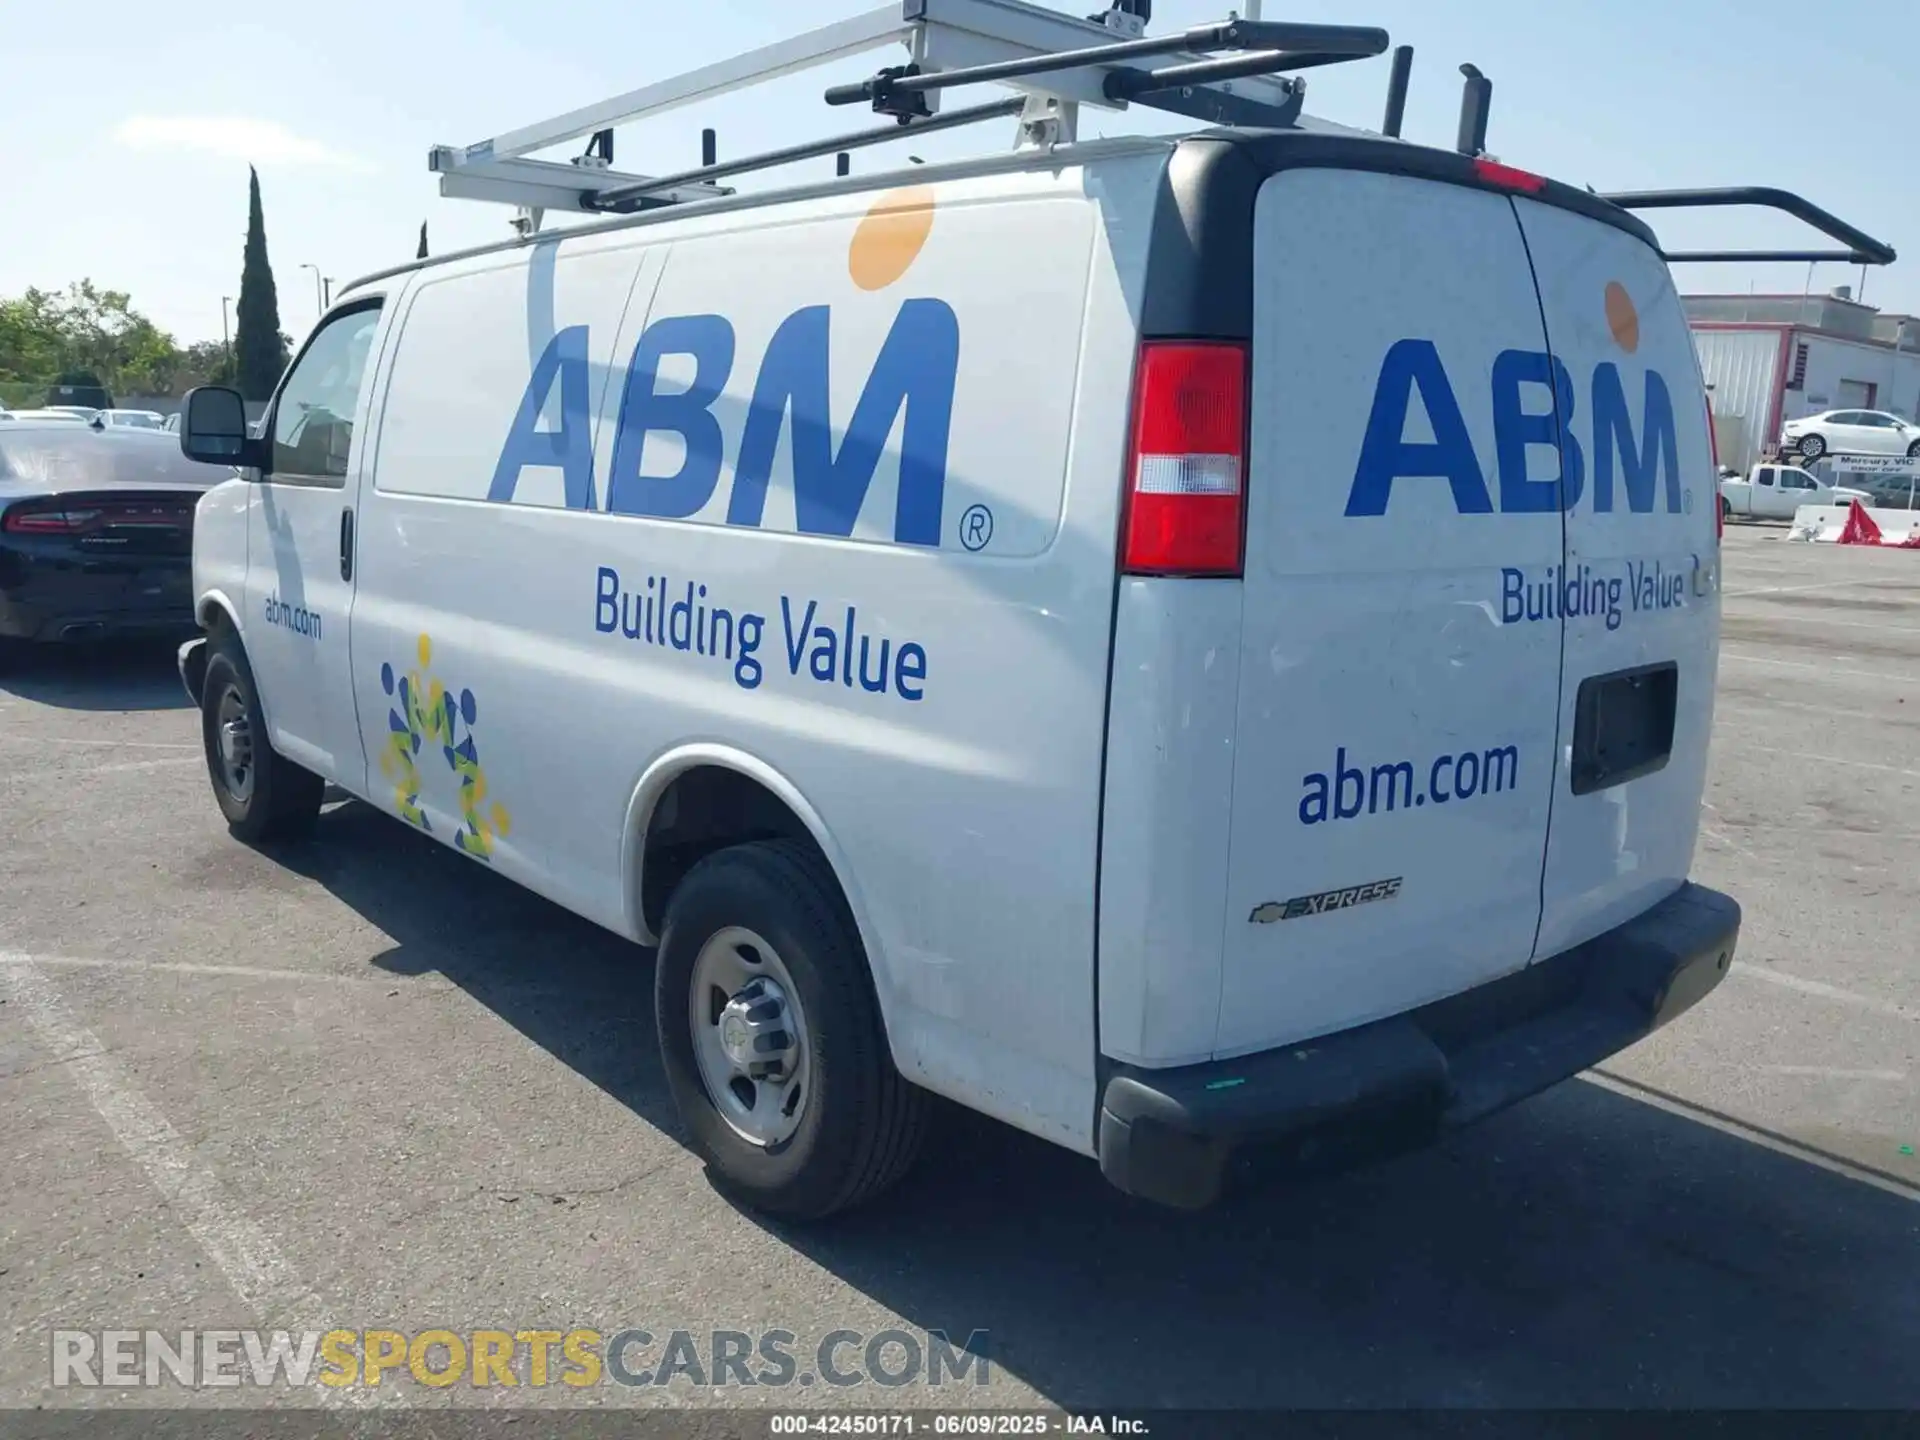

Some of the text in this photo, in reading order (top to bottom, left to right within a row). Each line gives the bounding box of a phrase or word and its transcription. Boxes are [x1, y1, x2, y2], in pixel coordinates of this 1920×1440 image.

[486, 297, 960, 547] ABM
[1344, 338, 1682, 517] ABM
[265, 588, 322, 641] abm.com
[595, 566, 928, 701] Building Value
[1501, 559, 1684, 631] Building Value
[1298, 744, 1519, 825] abm.com
[1283, 876, 1403, 919] EXPRESS
